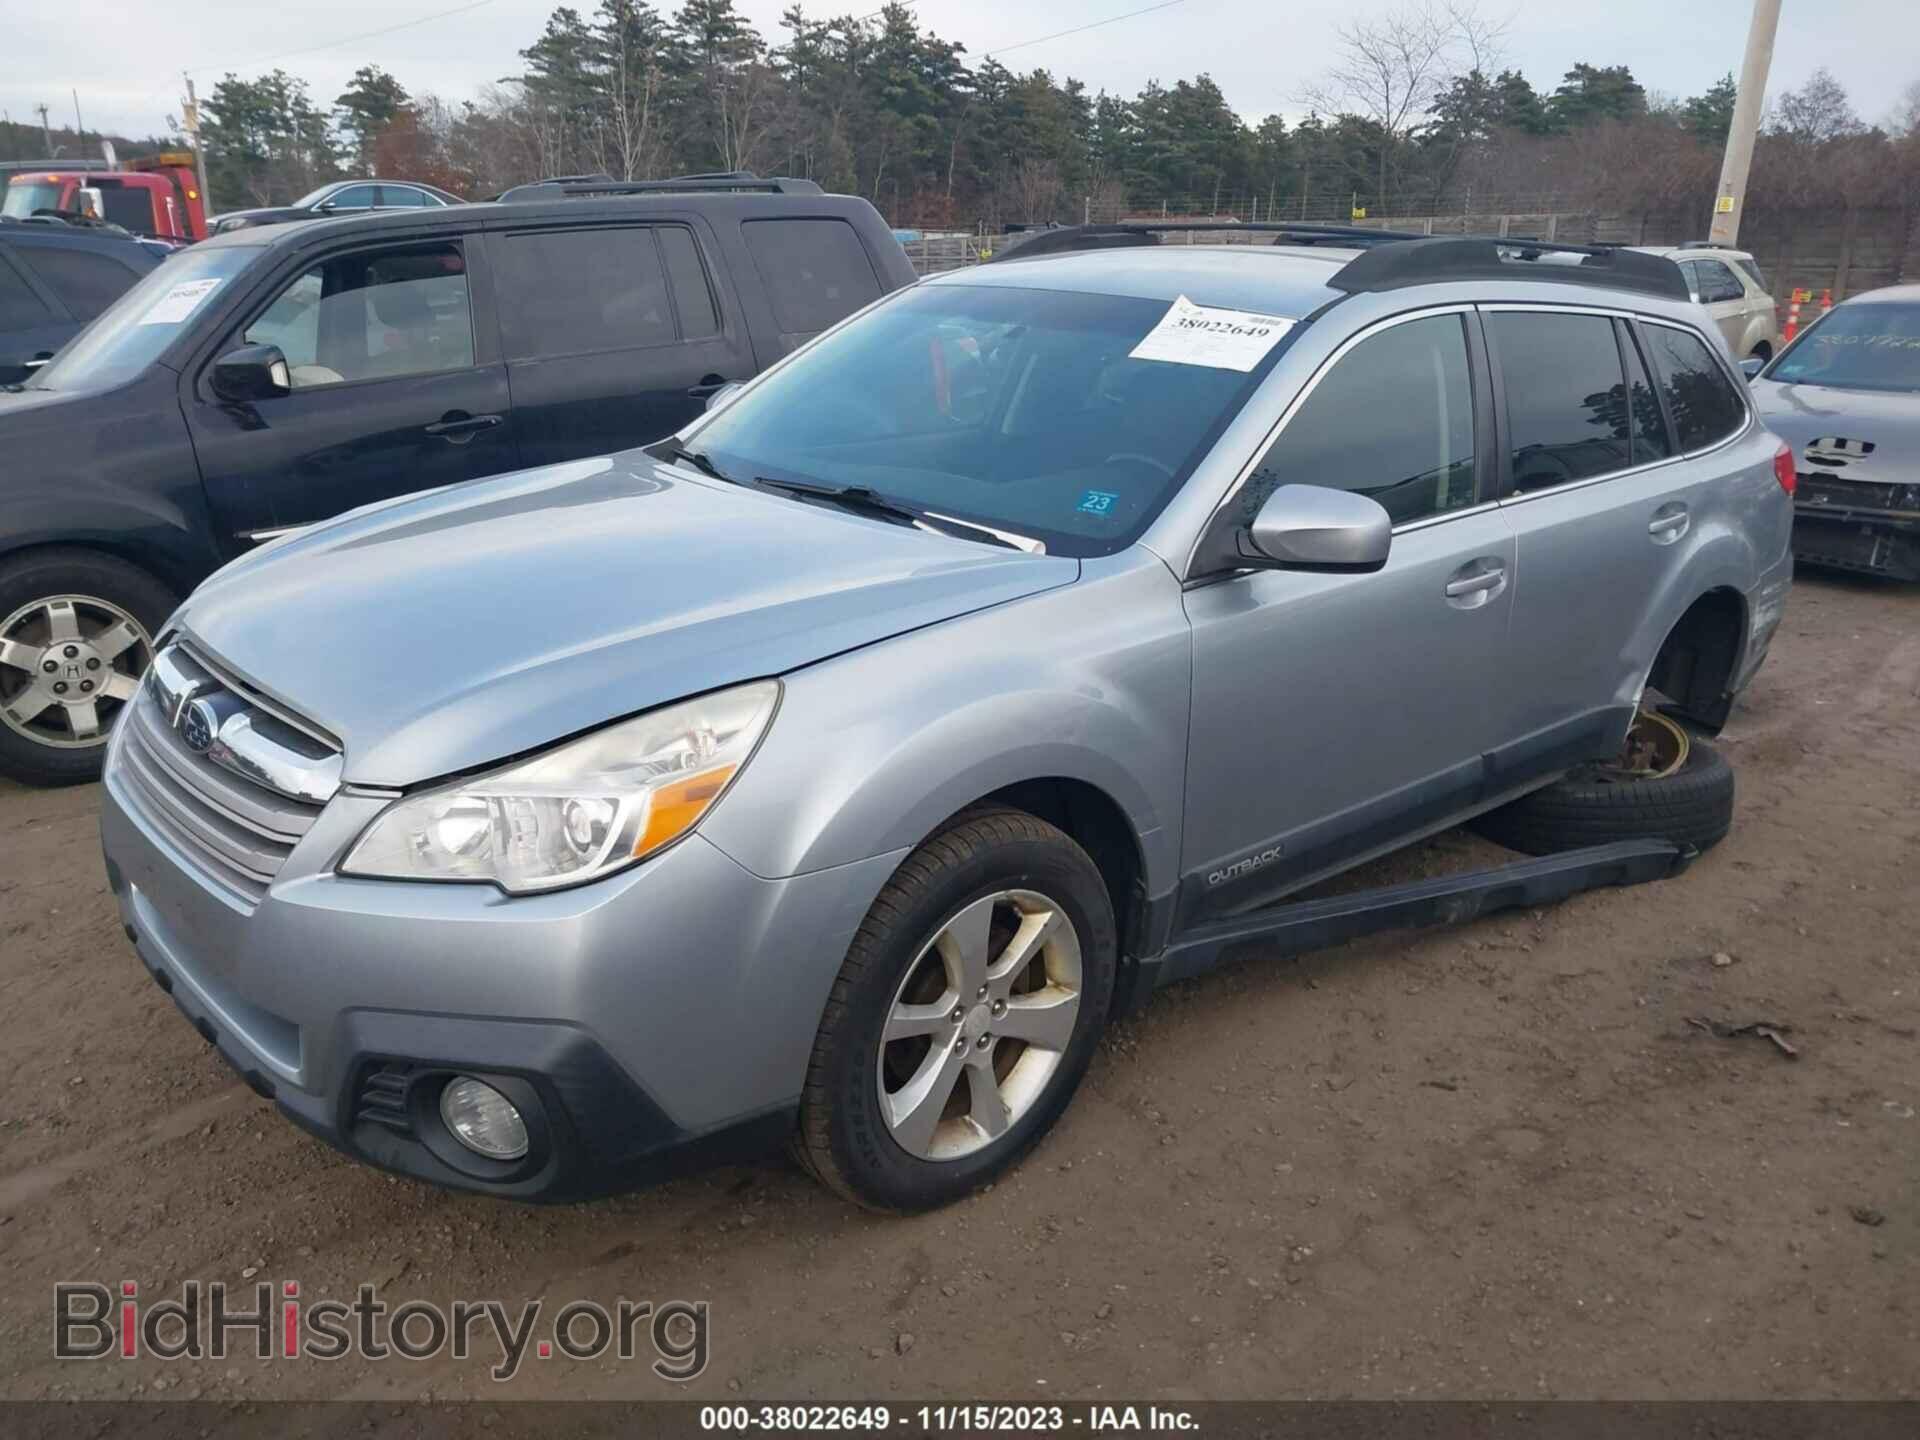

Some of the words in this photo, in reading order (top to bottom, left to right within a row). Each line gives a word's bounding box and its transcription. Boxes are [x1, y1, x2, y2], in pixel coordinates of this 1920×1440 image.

[1171, 317, 1270, 337] 38022649
[1082, 495, 1111, 510] 23
[1208, 846, 1281, 885] OUTBACK
